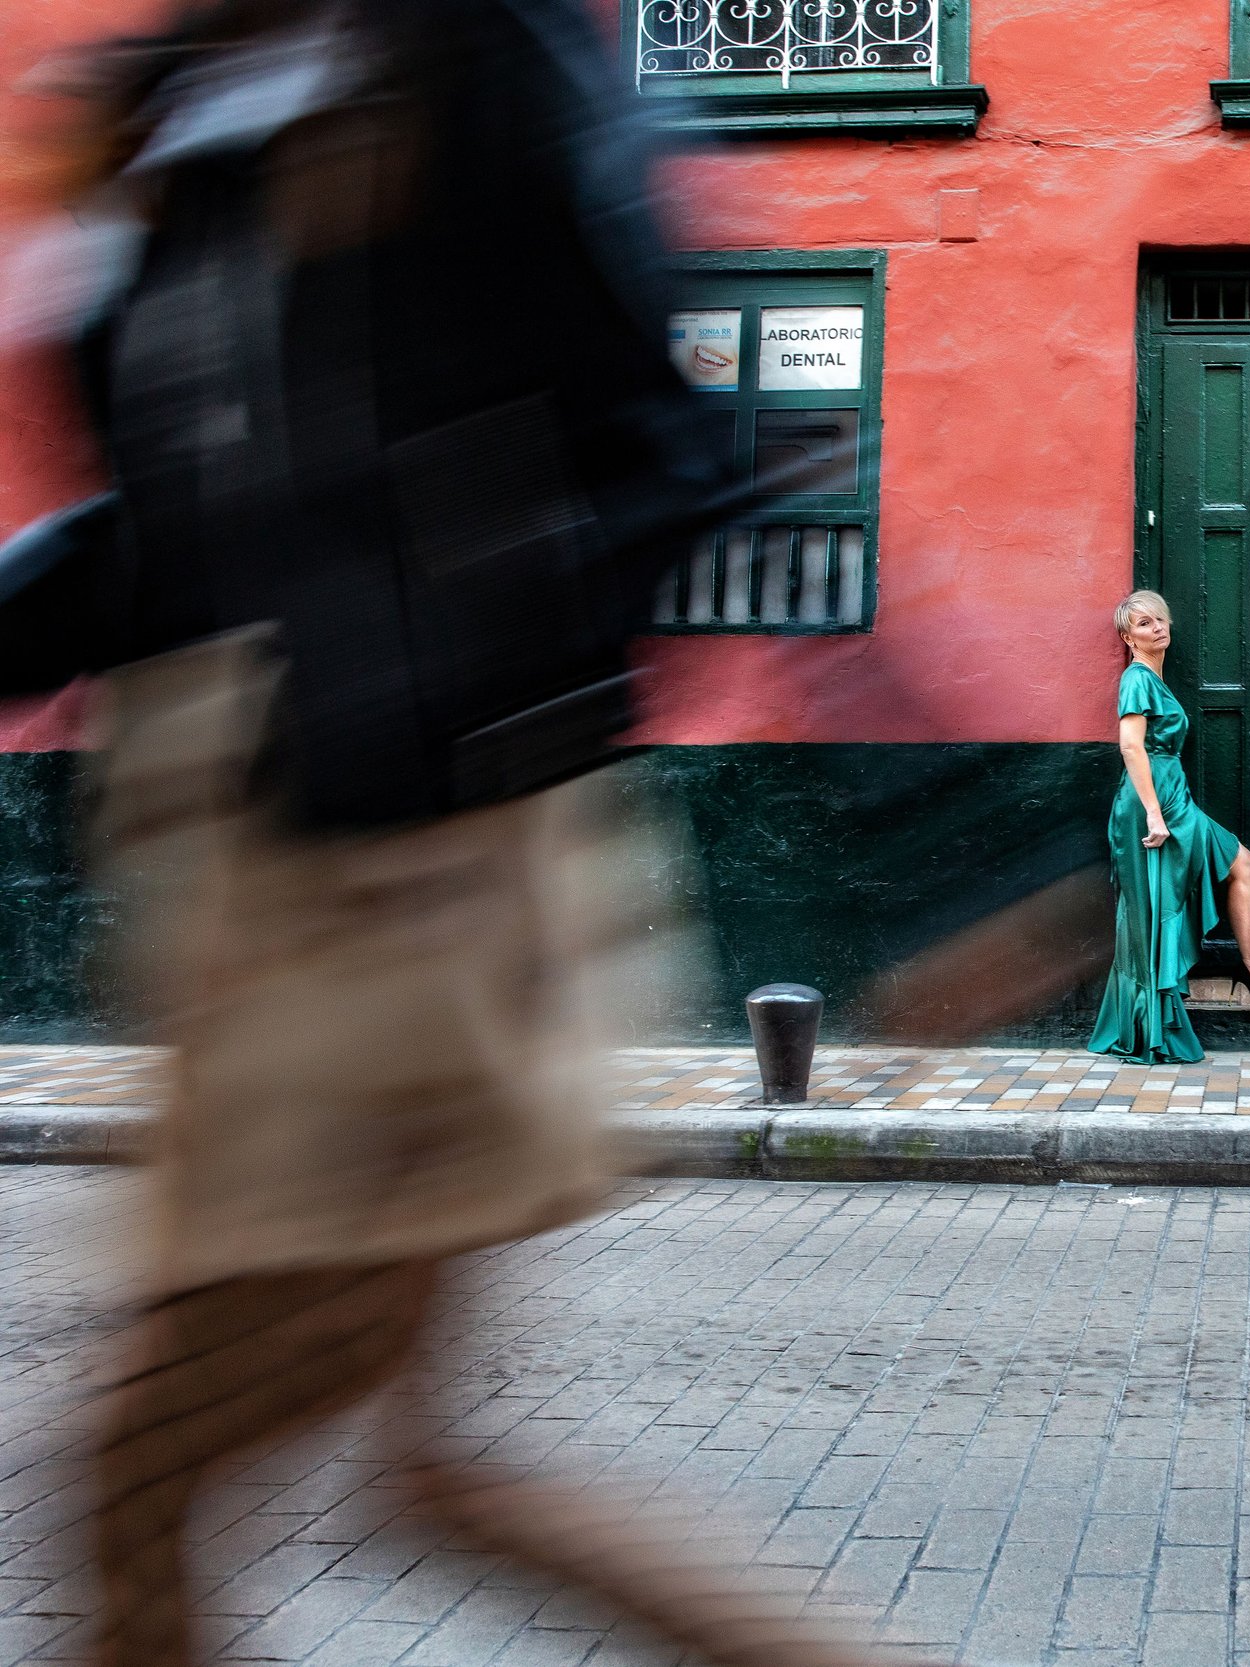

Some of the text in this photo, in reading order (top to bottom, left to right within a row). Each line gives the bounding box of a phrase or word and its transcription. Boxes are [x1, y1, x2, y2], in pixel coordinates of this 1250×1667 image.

[698, 328, 732, 336] SONIA RR
[781, 352, 846, 367] DENTAL
